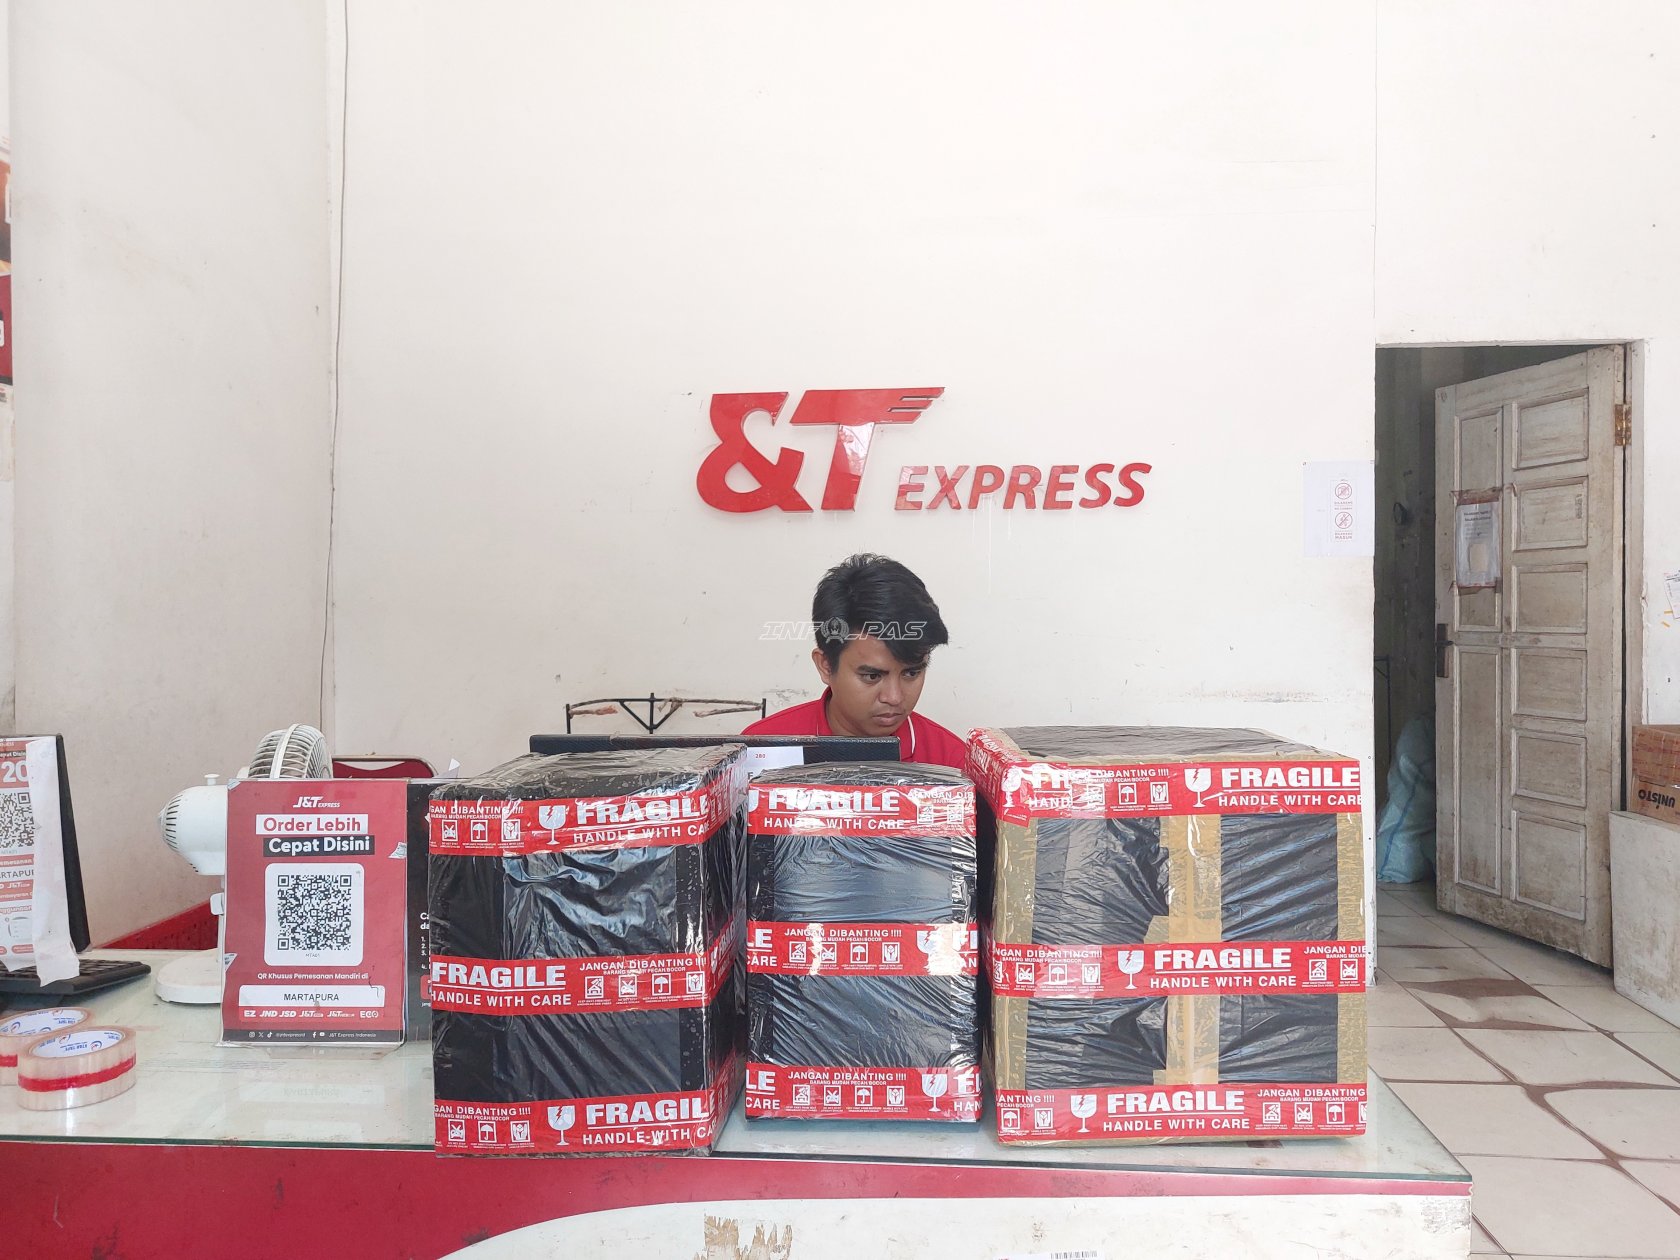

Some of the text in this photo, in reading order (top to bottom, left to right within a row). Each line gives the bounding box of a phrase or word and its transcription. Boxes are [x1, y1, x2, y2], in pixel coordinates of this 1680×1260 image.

[894, 462, 1152, 511] EXPRESS
[1222, 767, 1360, 788] FRAGILE
[292, 796, 324, 808] J&T
[1218, 795, 1278, 807] HANDLE
[1284, 795, 1322, 806] WITH
[263, 817, 361, 832] Order Lebih
[827, 818, 862, 829] WITH
[868, 819, 906, 830] CARE
[573, 829, 636, 844] HANDLE
[642, 826, 680, 839] WITH
[268, 836, 370, 857] Cepat Disini
[784, 928, 825, 937] JANGAN
[830, 929, 889, 937] DIBANTING
[1027, 949, 1088, 958] DIBANTING
[1304, 946, 1346, 955] JANGAN
[579, 962, 624, 971] JANGAN
[629, 958, 693, 970] DIBANTING
[1154, 948, 1292, 970] FRAGILE
[268, 972, 293, 980] Khusus
[334, 972, 360, 980] Mandiri
[361, 972, 369, 980] di
[432, 962, 567, 988] FRAGILE
[1150, 976, 1210, 988] HANDLE
[1216, 976, 1253, 987] WITH
[1258, 975, 1297, 987] CARE
[283, 993, 340, 1002] MARTAPURA
[431, 990, 481, 1005] HANDLE
[486, 995, 524, 1007] WITH
[531, 994, 572, 1006] CARE
[259, 1010, 278, 1018] JND
[279, 1010, 297, 1018] JSD
[788, 1071, 829, 1080] JANGAN
[834, 1072, 894, 1081] DIBANTING
[1257, 1089, 1366, 1097] JANGAN DIBANTING
[746, 1097, 781, 1110] CARE
[1107, 1090, 1245, 1114] FRAGILE
[457, 1106, 517, 1116] DIBANTING
[1103, 1119, 1162, 1131] HANDLE
[1168, 1119, 1205, 1130] WITH
[1211, 1118, 1250, 1130] CARE
[582, 1130, 645, 1145] HANDLE
